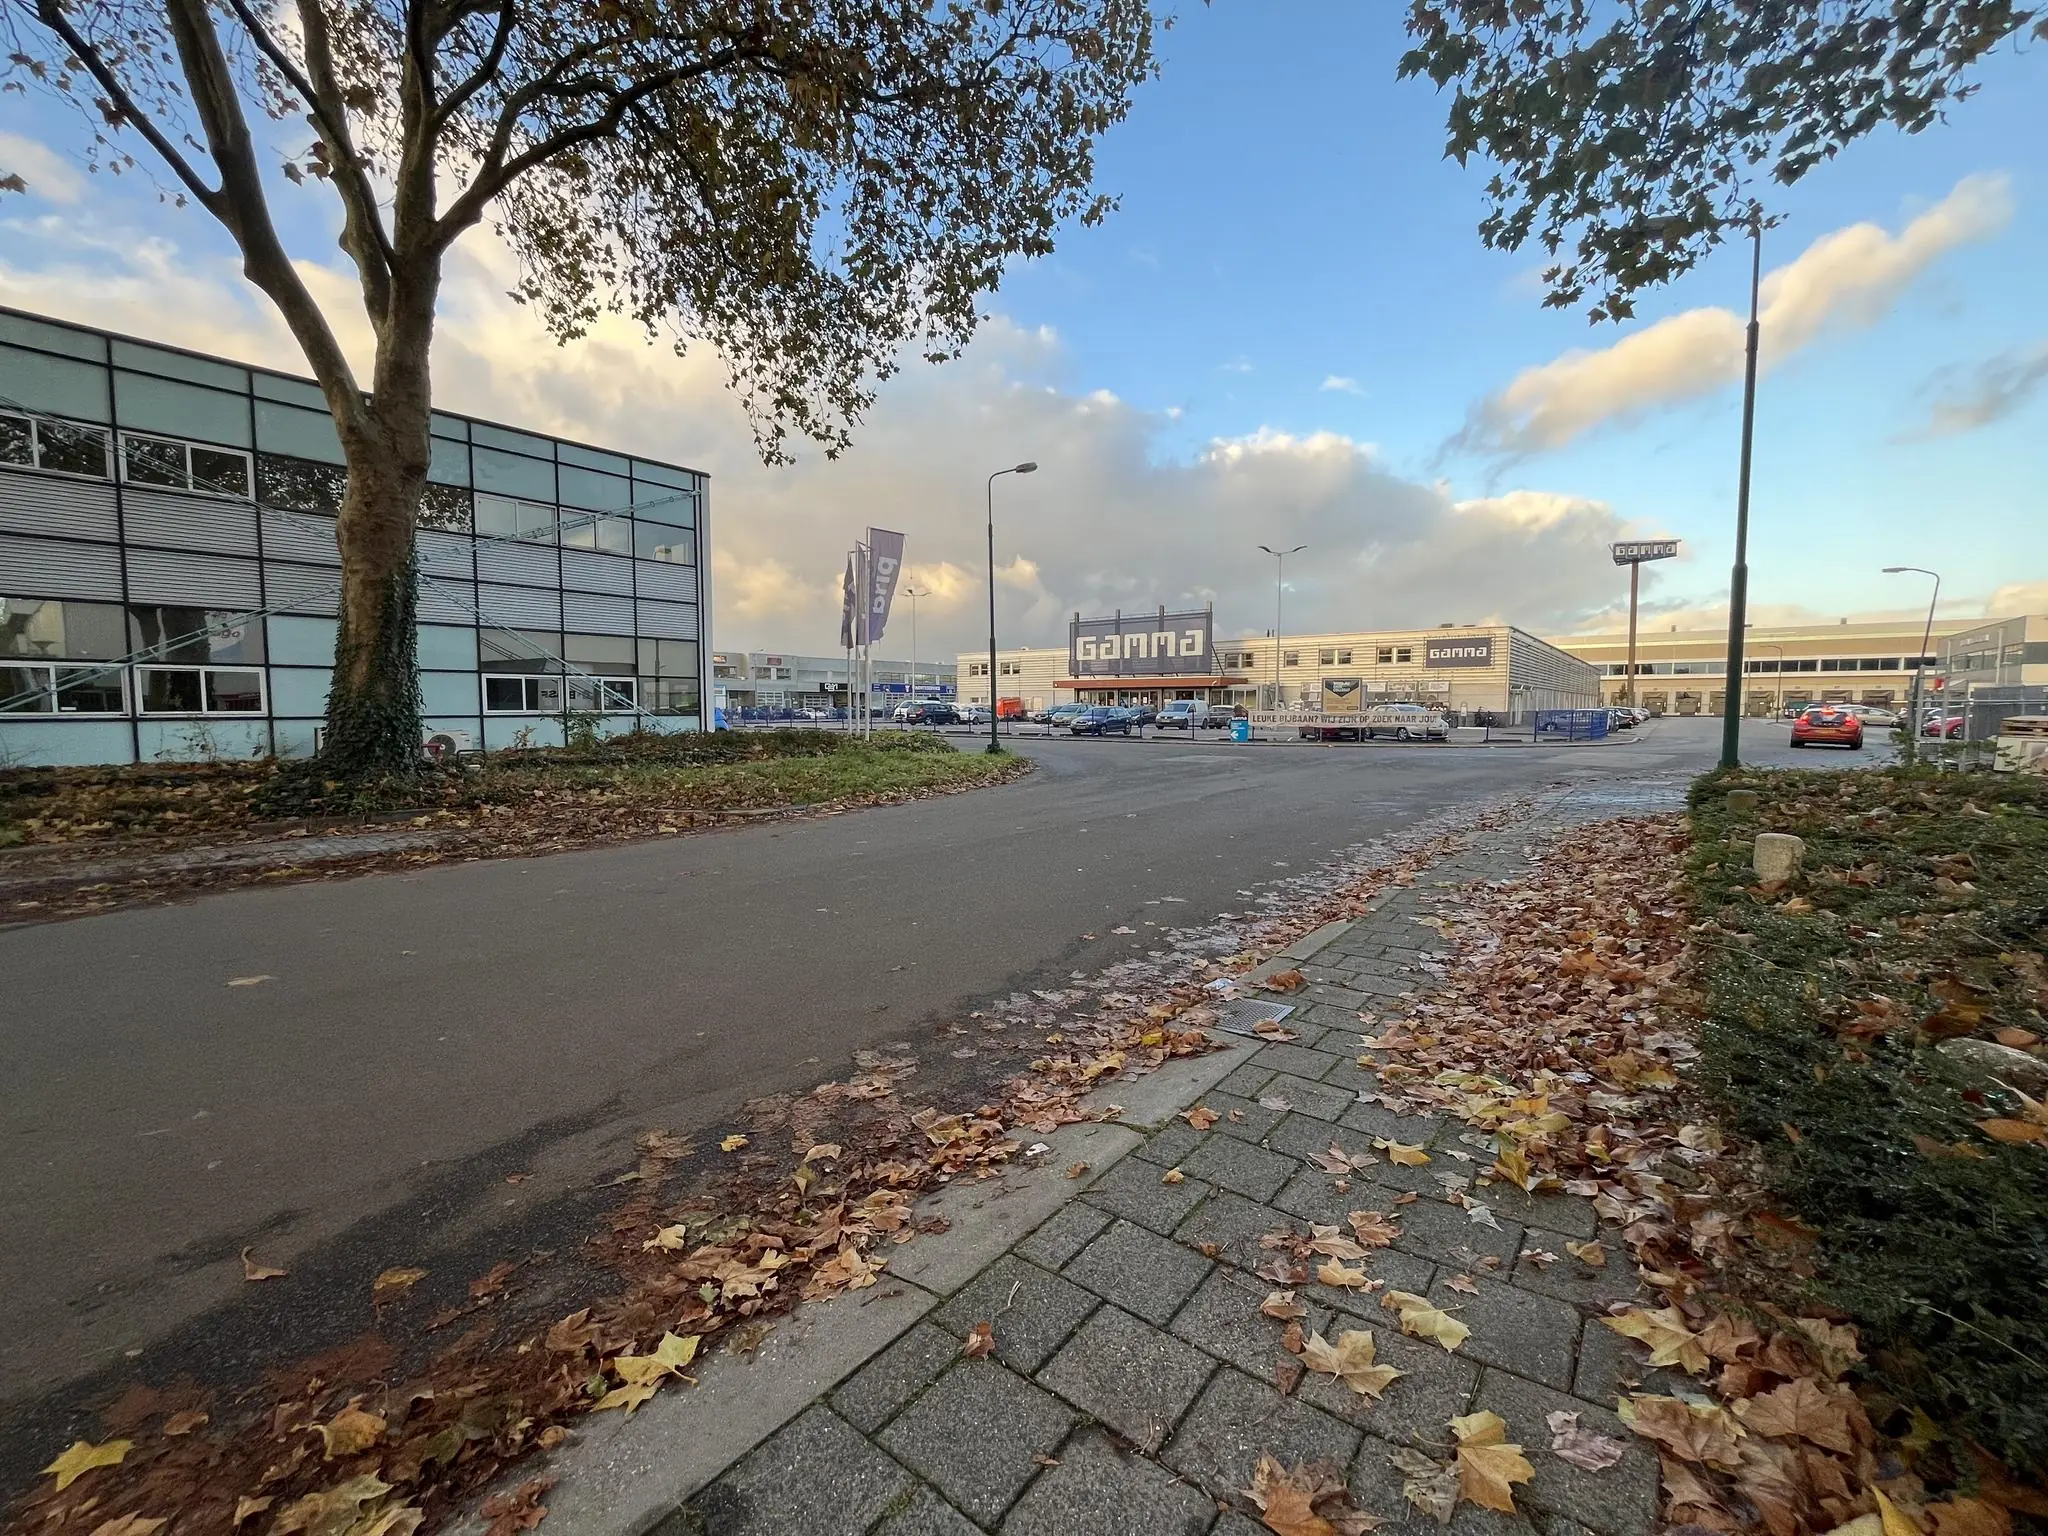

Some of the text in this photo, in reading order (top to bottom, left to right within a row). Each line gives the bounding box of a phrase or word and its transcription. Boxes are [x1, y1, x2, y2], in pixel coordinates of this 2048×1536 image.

[1280, 715, 1319, 723] BIJBAAN?
[1321, 715, 1336, 723] WIJ
[1338, 715, 1357, 723] ZIJN
[1360, 715, 1370, 723] OP
[1373, 715, 1392, 723] ZOEK
[1395, 715, 1416, 723] NAAR
